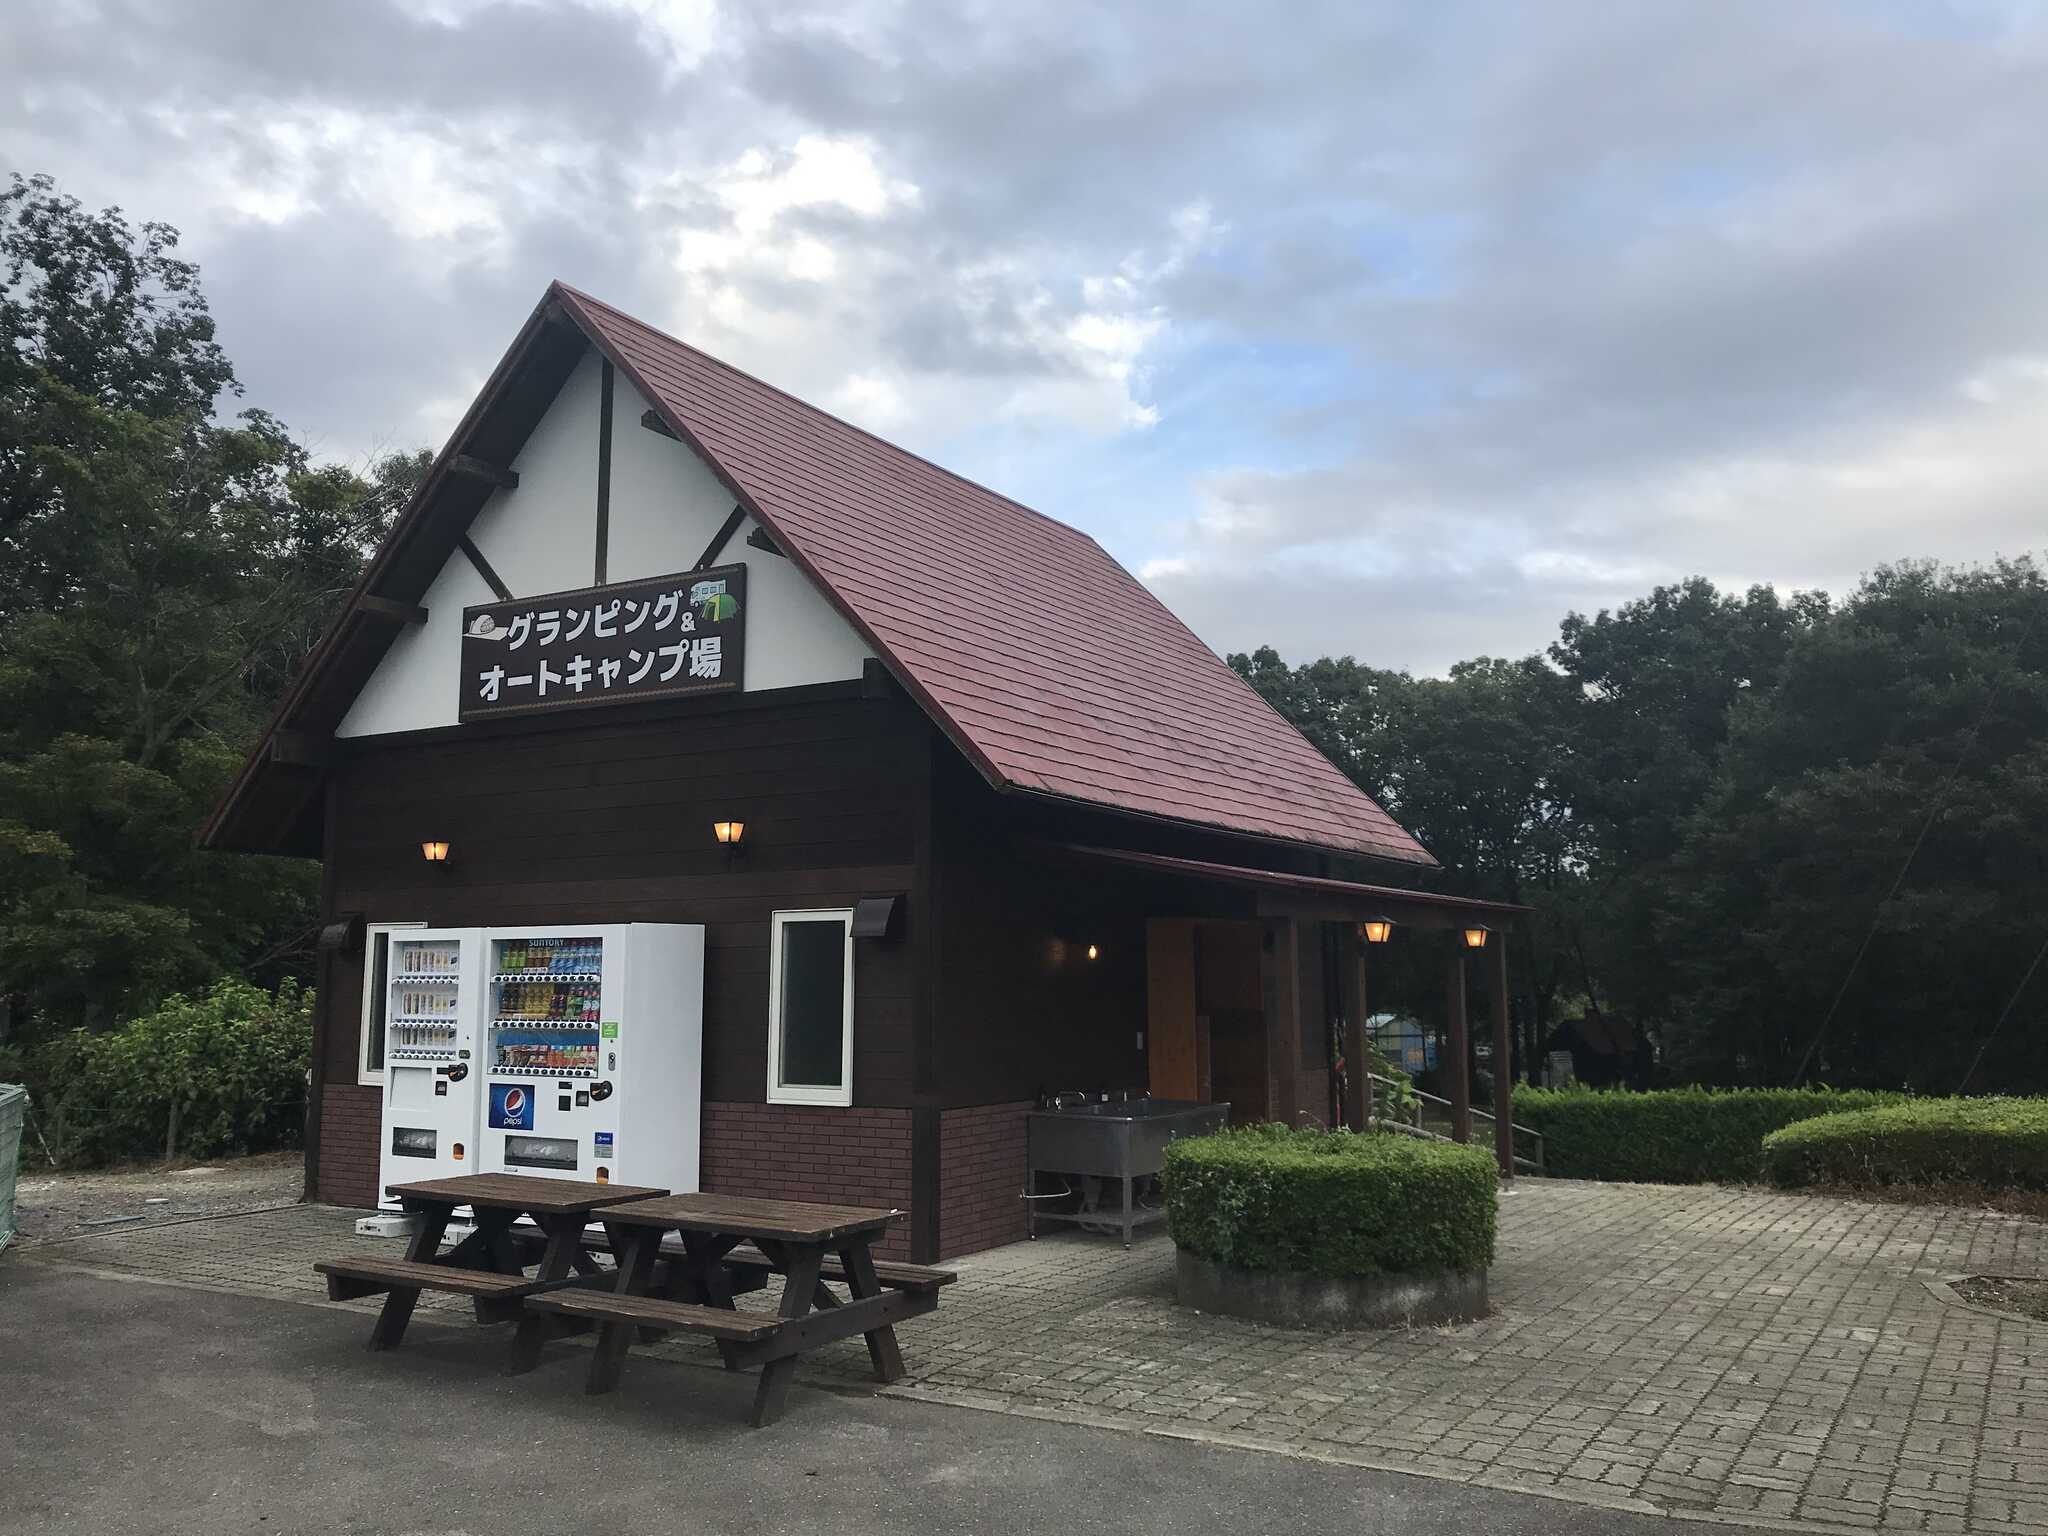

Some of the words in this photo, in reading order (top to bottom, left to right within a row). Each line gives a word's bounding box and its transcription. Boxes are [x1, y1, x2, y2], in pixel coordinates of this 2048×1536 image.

[479, 636, 722, 701] オートキャンプ場
[503, 1117, 522, 1126] pepsi
